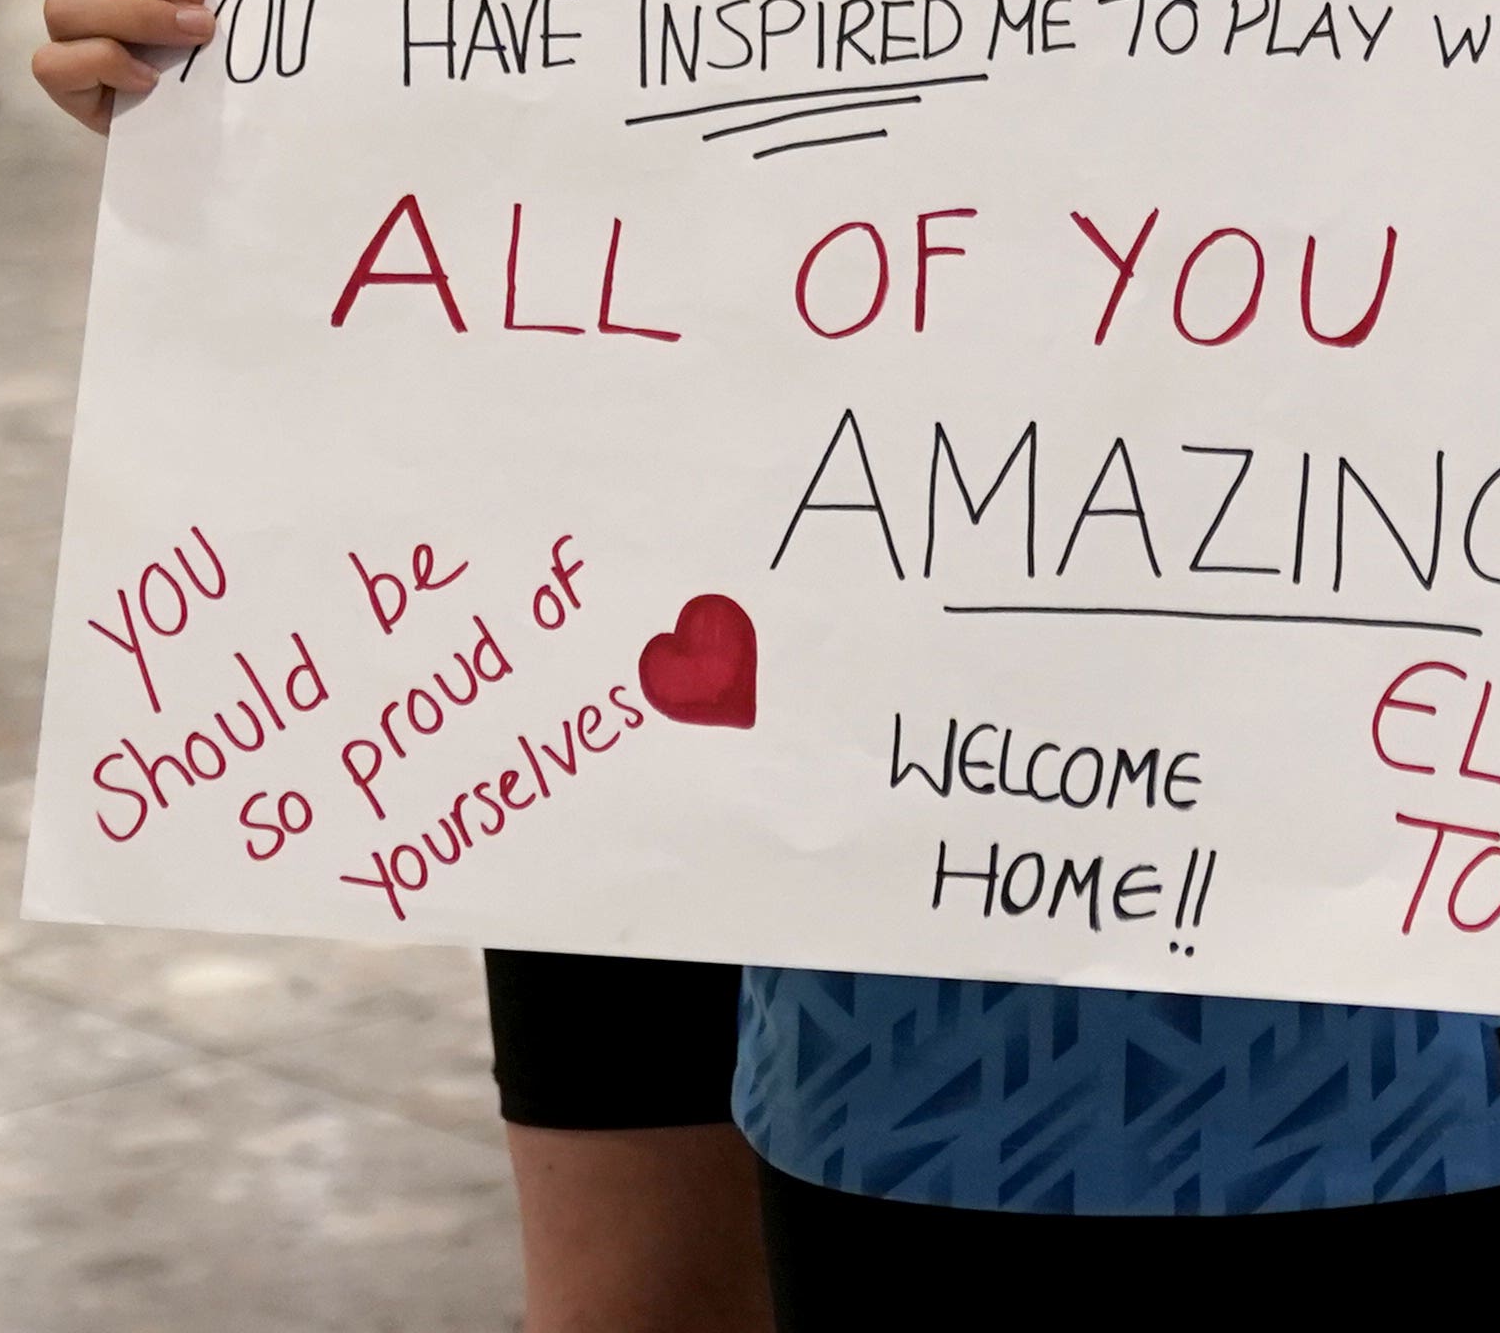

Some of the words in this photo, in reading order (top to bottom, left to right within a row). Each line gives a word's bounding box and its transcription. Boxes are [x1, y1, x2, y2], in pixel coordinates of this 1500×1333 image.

[330, 193, 683, 343] ALL
[794, 207, 979, 341] OF
[1069, 206, 1398, 349] YOU
[347, 542, 470, 636] be
[341, 614, 514, 821] proud
[889, 711, 1203, 812] WELCOME
[339, 683, 645, 923] yourselves
[931, 839, 1218, 958] HOME!!
